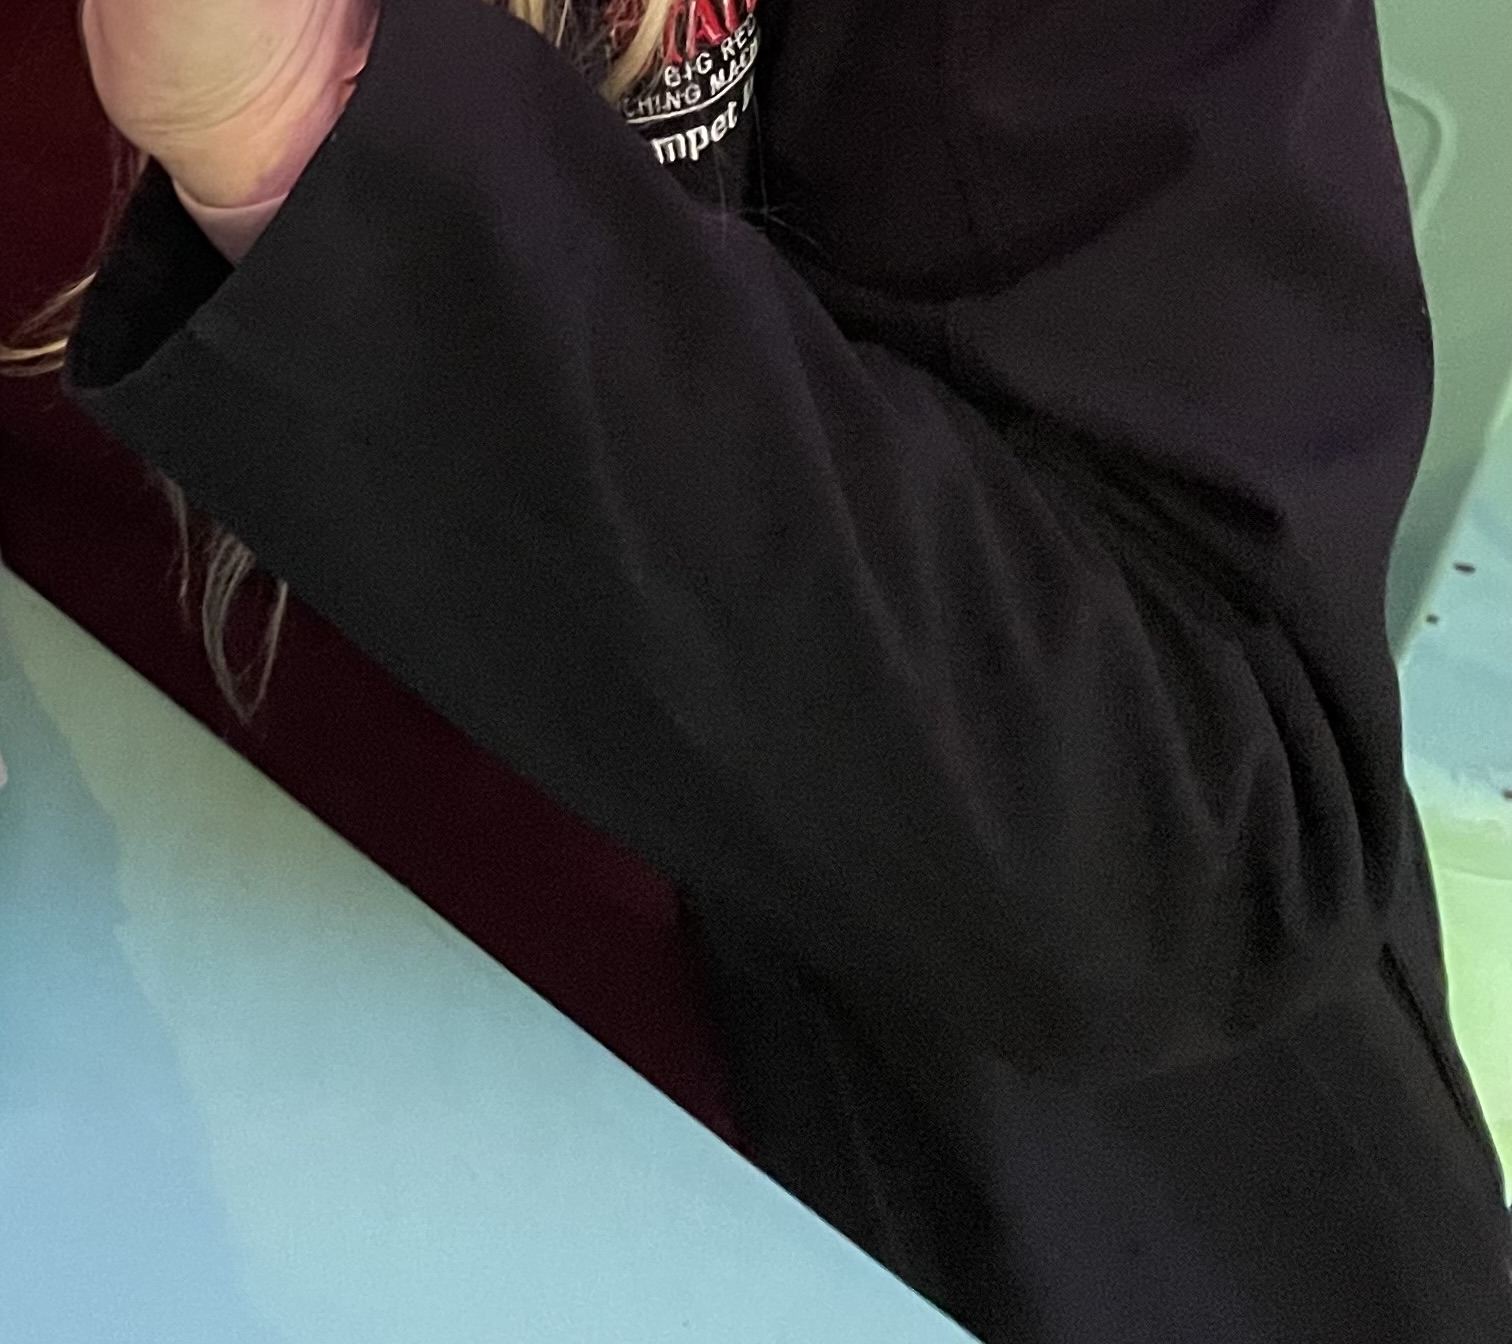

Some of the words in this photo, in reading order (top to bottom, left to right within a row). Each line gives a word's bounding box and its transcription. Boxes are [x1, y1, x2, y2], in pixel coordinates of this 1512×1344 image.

[664, 52, 713, 87] BIG
[721, 13, 756, 61] RED
[651, 100, 738, 165] mpet
